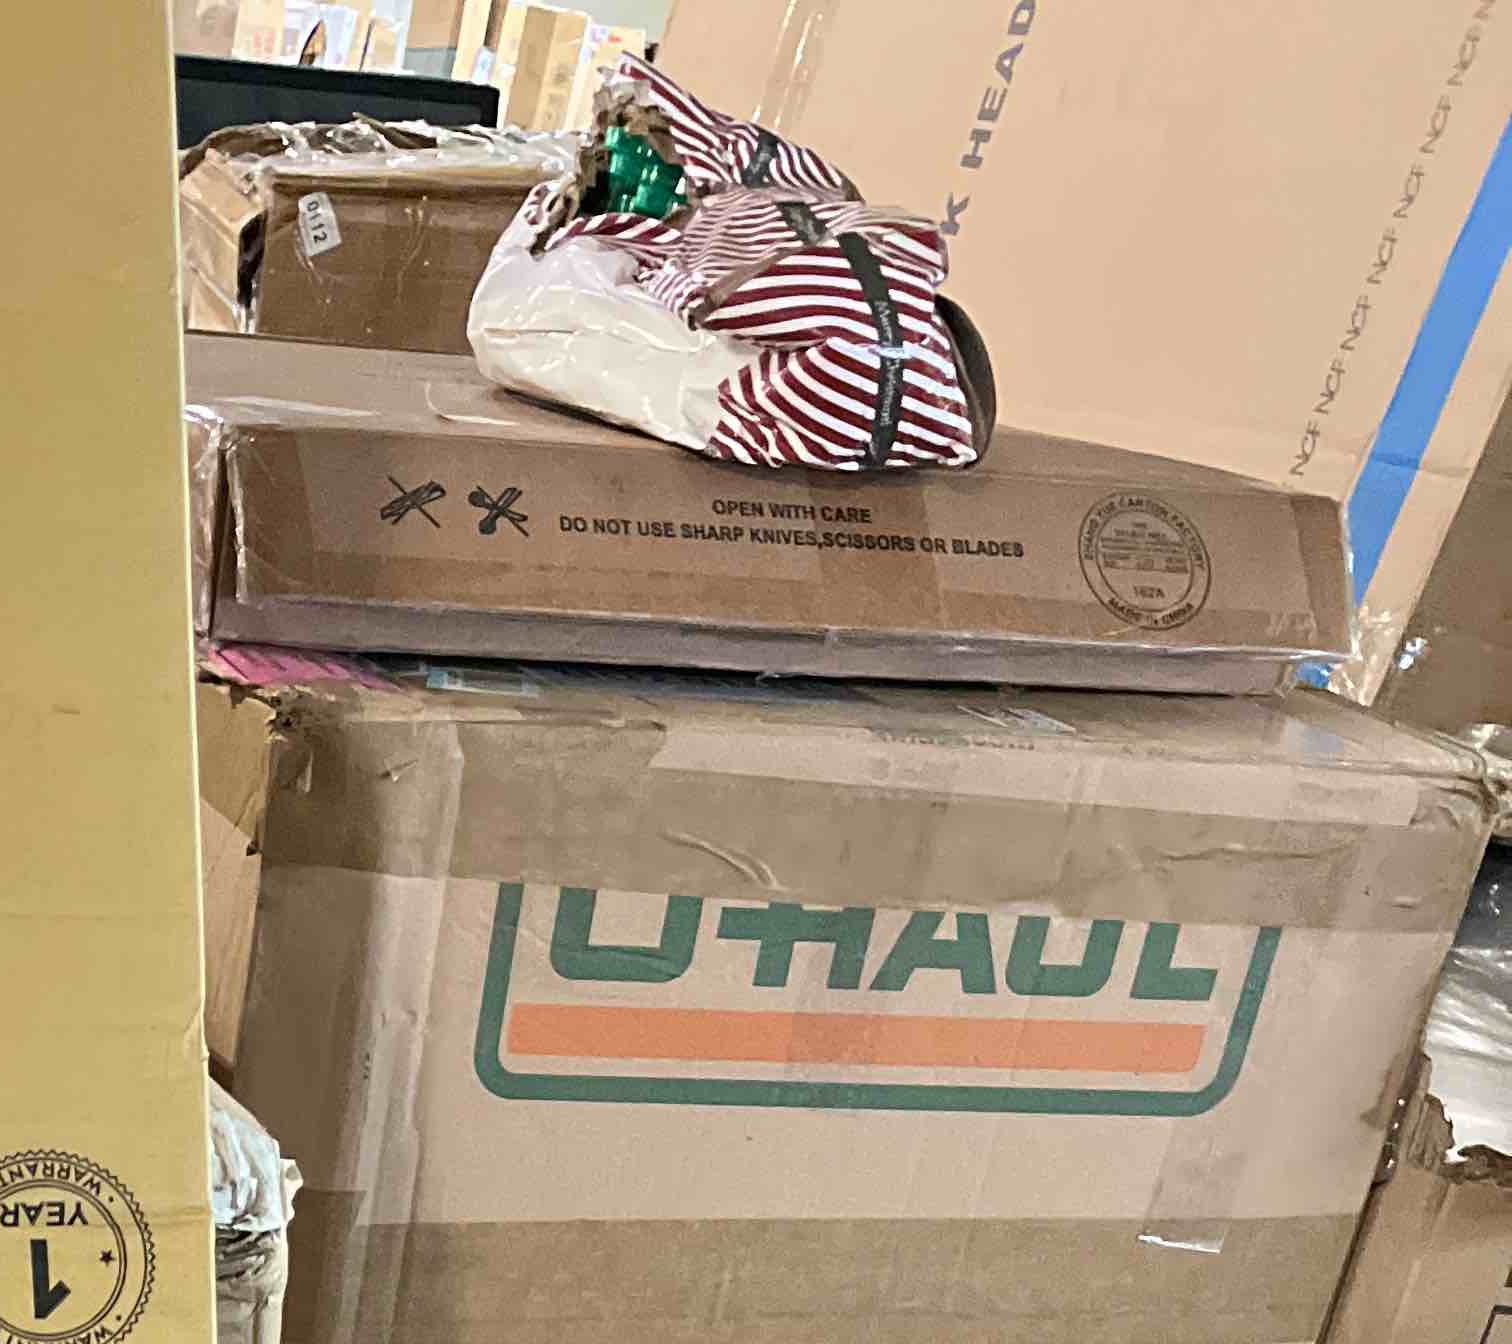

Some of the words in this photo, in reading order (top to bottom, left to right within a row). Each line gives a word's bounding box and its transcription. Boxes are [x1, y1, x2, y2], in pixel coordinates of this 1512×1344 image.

[960, 0, 1036, 169] HEAD
[712, 499, 765, 518] OPEN
[768, 502, 816, 521] WITH
[820, 505, 873, 524] CARE
[559, 515, 587, 533] DO
[592, 517, 632, 536] NOT
[637, 520, 676, 539] USE
[680, 522, 745, 542] SHARP
[919, 537, 947, 554] OR
[952, 538, 1025, 559] BLADES
[0, 1200, 88, 1228] YEAR
[29, 1239, 71, 1319] 1
